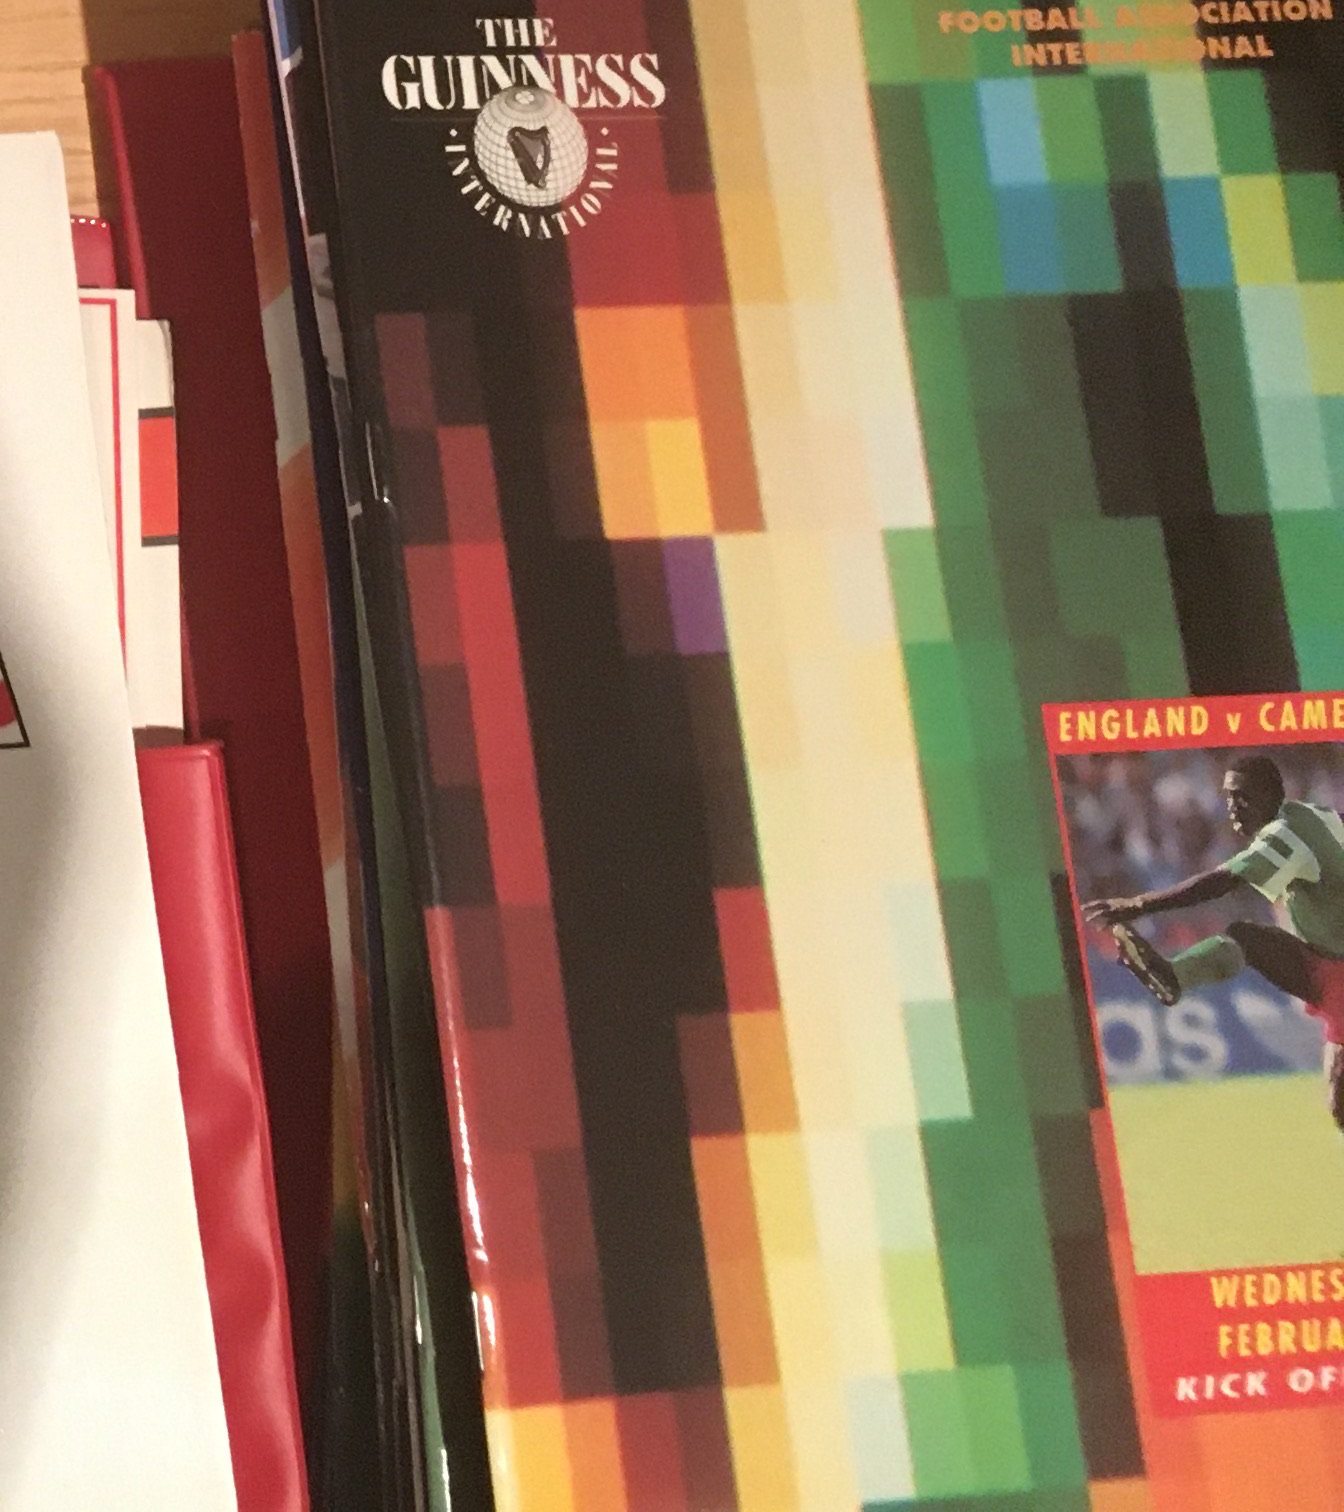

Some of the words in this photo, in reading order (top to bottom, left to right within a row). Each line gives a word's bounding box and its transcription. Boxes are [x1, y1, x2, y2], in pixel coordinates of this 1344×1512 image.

[475, 16, 556, 48] THE
[939, 7, 1103, 34] FOOTBALL
[1012, 35, 1274, 67] INTERNATIONAL
[381, 52, 666, 110] GUINNESS
[444, 140, 619, 240] INTERNATIONAL
[1058, 705, 1210, 742] ENGLAND
[1226, 712, 1242, 734] v
[1210, 1268, 1344, 1308] WEDNES
[1176, 1370, 1268, 1402] KICK
[1287, 1365, 1344, 1394] OF
